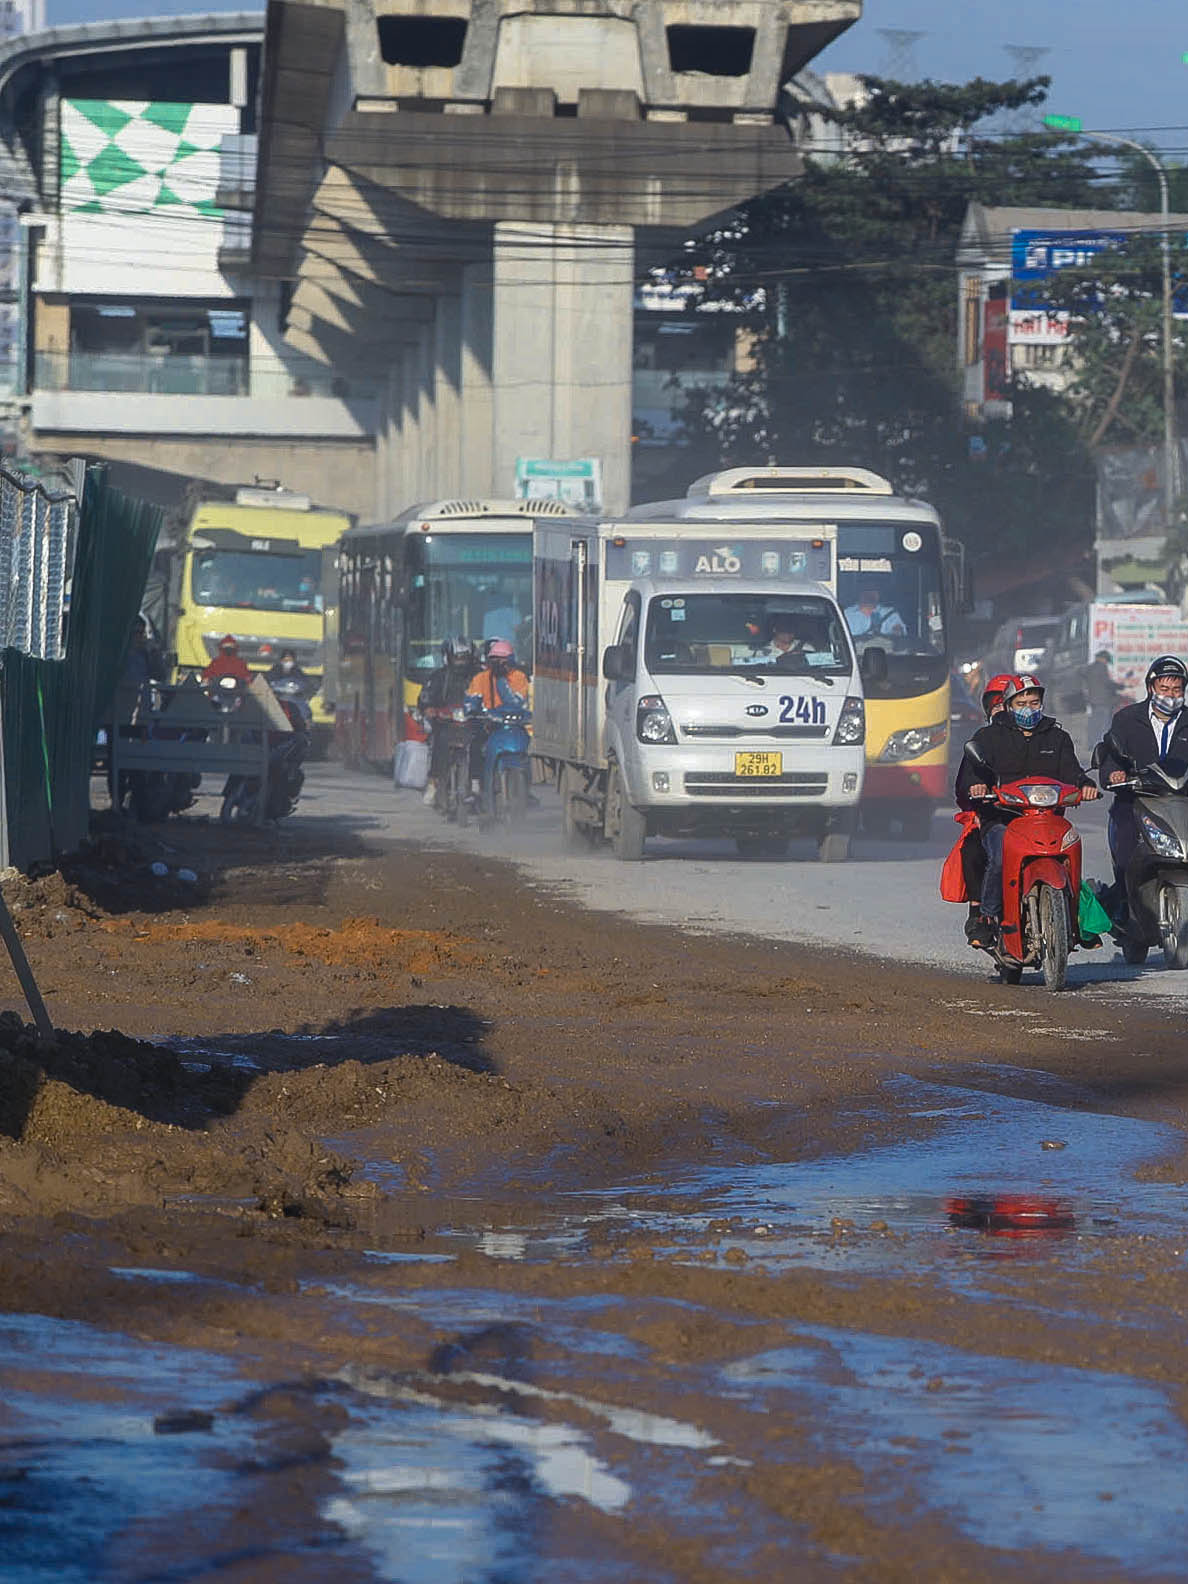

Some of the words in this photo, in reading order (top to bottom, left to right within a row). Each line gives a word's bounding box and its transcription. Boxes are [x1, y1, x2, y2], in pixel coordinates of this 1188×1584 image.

[696, 556, 740, 572] ALO
[747, 706, 767, 715] KIA
[779, 695, 826, 724] 24h
[748, 754, 769, 764] 29H
